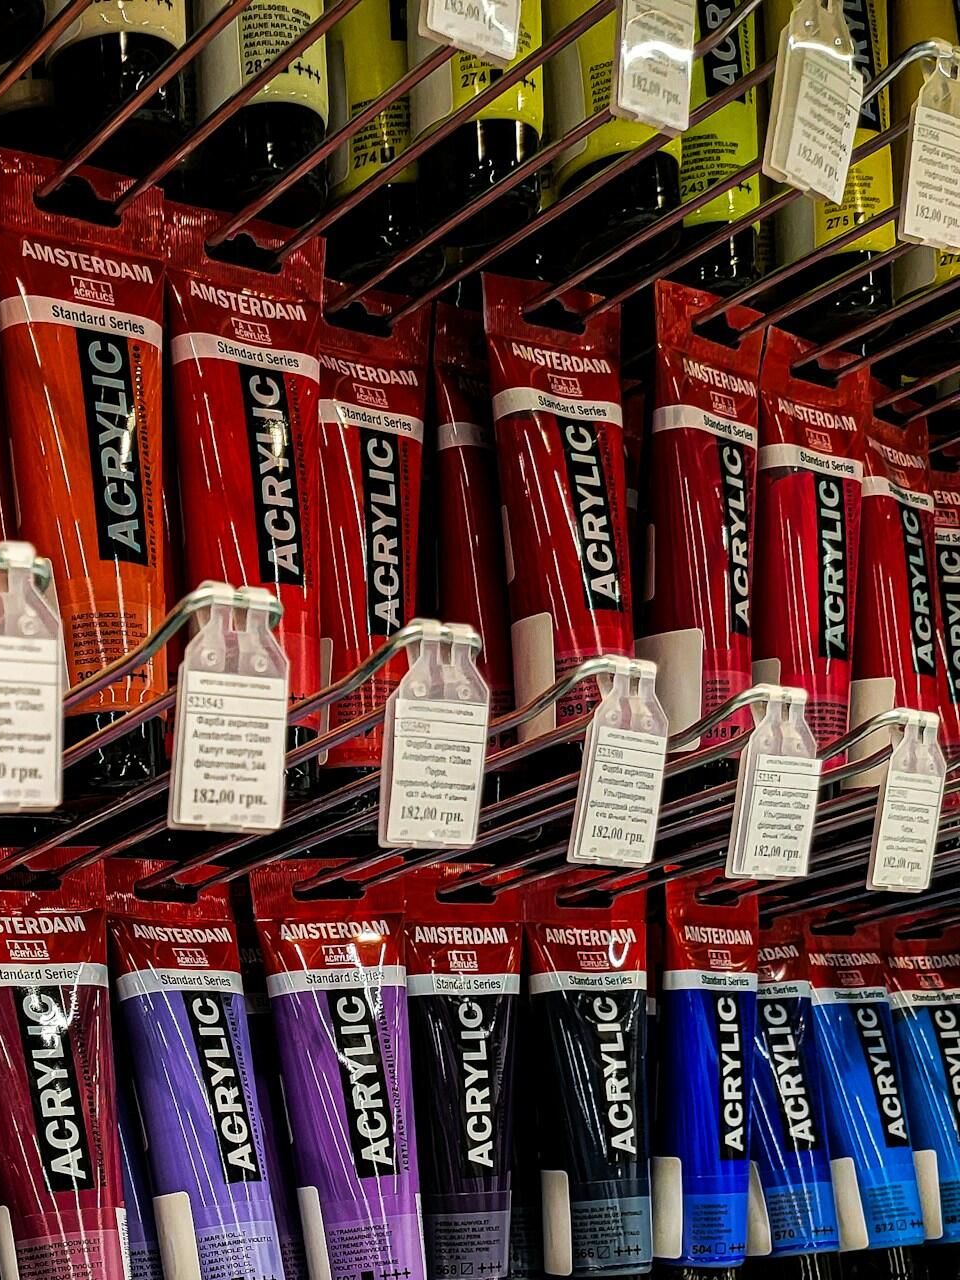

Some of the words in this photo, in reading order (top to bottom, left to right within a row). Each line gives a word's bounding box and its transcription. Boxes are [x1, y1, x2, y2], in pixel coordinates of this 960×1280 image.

[353, 151, 377, 169] 274
[826, 215, 849, 230] 275
[21, 239, 153, 284] AMSTERDAM
[511, 342, 611, 374] AMSTERDAM
[87, 340, 141, 554] ACRYLIC
[565, 424, 621, 602] ACRYLIC
[366, 438, 401, 629] ACRYLIC
[819, 480, 847, 651] ACRYLIC
[902, 507, 935, 670] ACRYLIC
[134, 924, 232, 943] AMSTERDAM
[683, 925, 753, 945] AMSTERDAM
[22, 993, 86, 1180] ACRYLIC
[193, 995, 257, 1173] ACRYLIC
[337, 995, 393, 1166] ACRYLIC
[456, 1000, 494, 1168] ACRYLIC
[718, 996, 744, 1152] ACRYLIC
[856, 1007, 907, 1140] ACRYLIC
